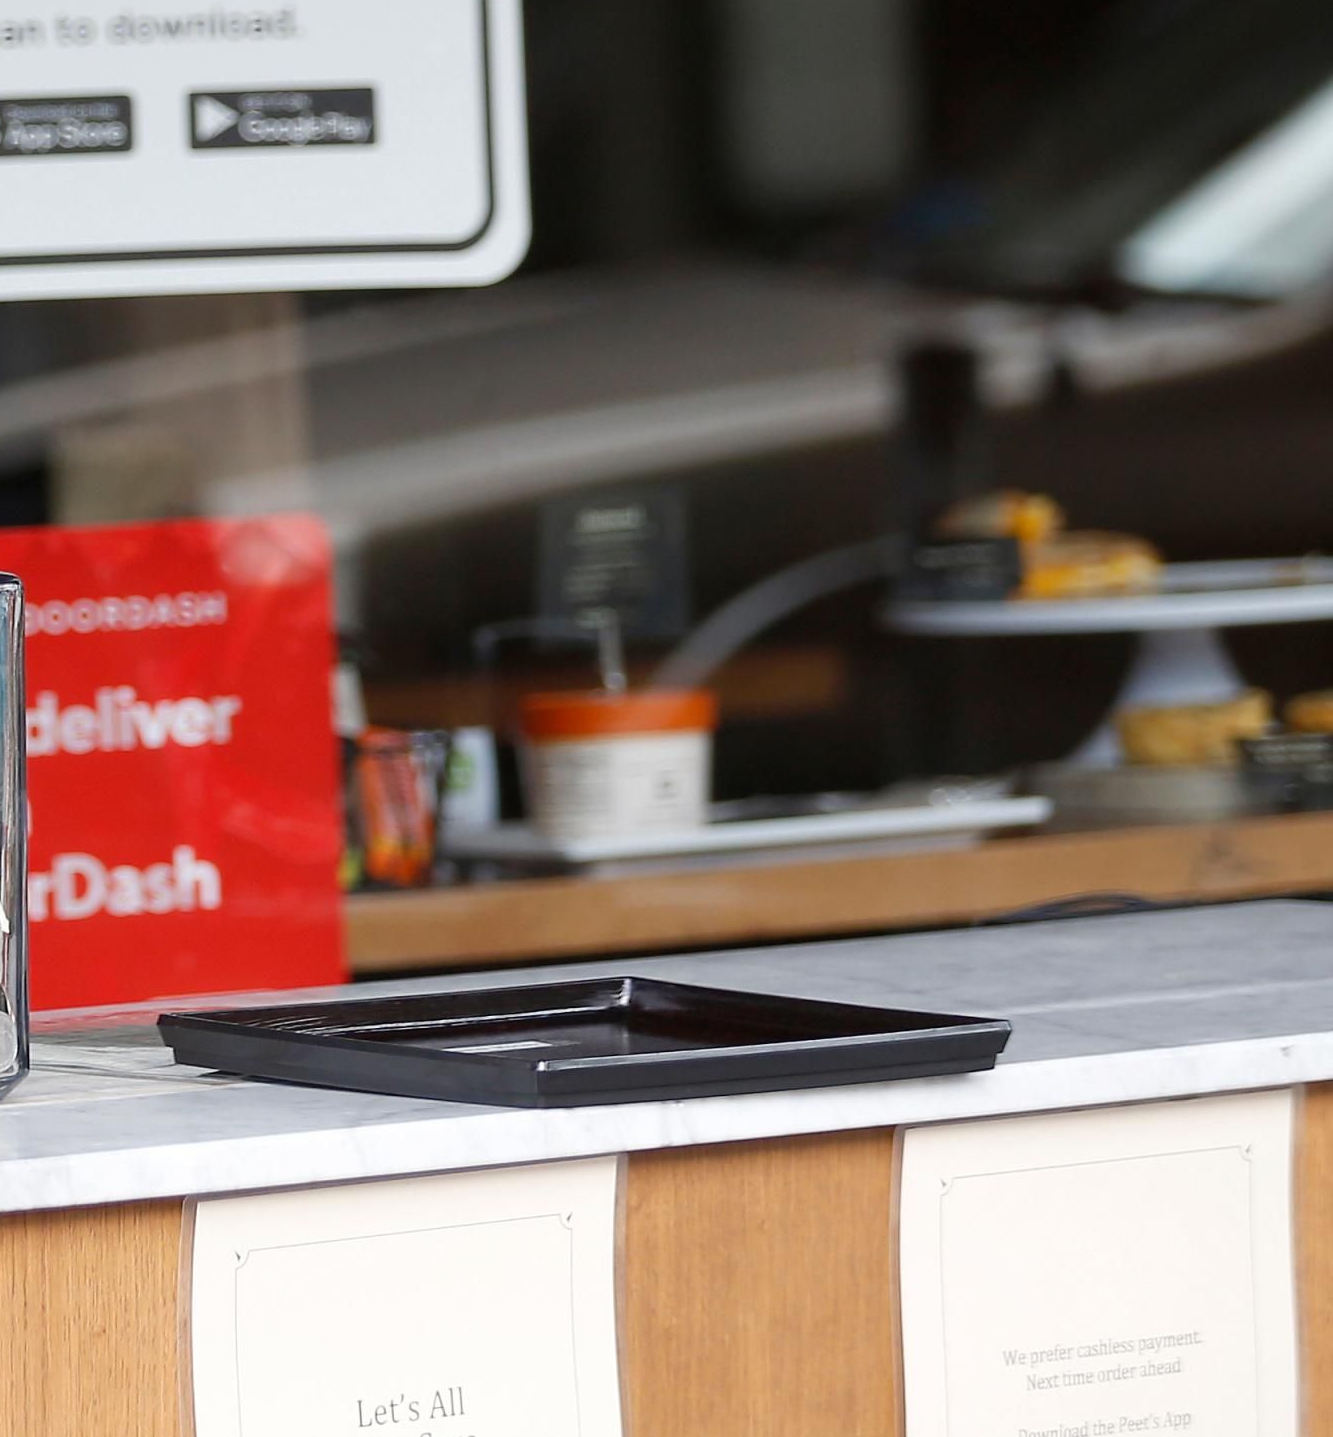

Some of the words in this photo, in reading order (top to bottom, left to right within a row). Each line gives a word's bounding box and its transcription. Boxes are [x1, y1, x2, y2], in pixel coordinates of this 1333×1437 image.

[55, 12, 98, 47] to
[28, 844, 222, 921] rDash
[1002, 1348, 1027, 1367] We
[1030, 1343, 1075, 1368] prefer
[1077, 1338, 1135, 1359] cashless
[1026, 1373, 1060, 1391] Next
[1062, 1370, 1094, 1387] time
[1097, 1363, 1137, 1383] order
[1140, 1357, 1182, 1378] ahead
[357, 1393, 420, 1428] Let's
[430, 1386, 465, 1419] All
[1092, 1417, 1115, 1436] the
[1163, 1411, 1193, 1431] App
